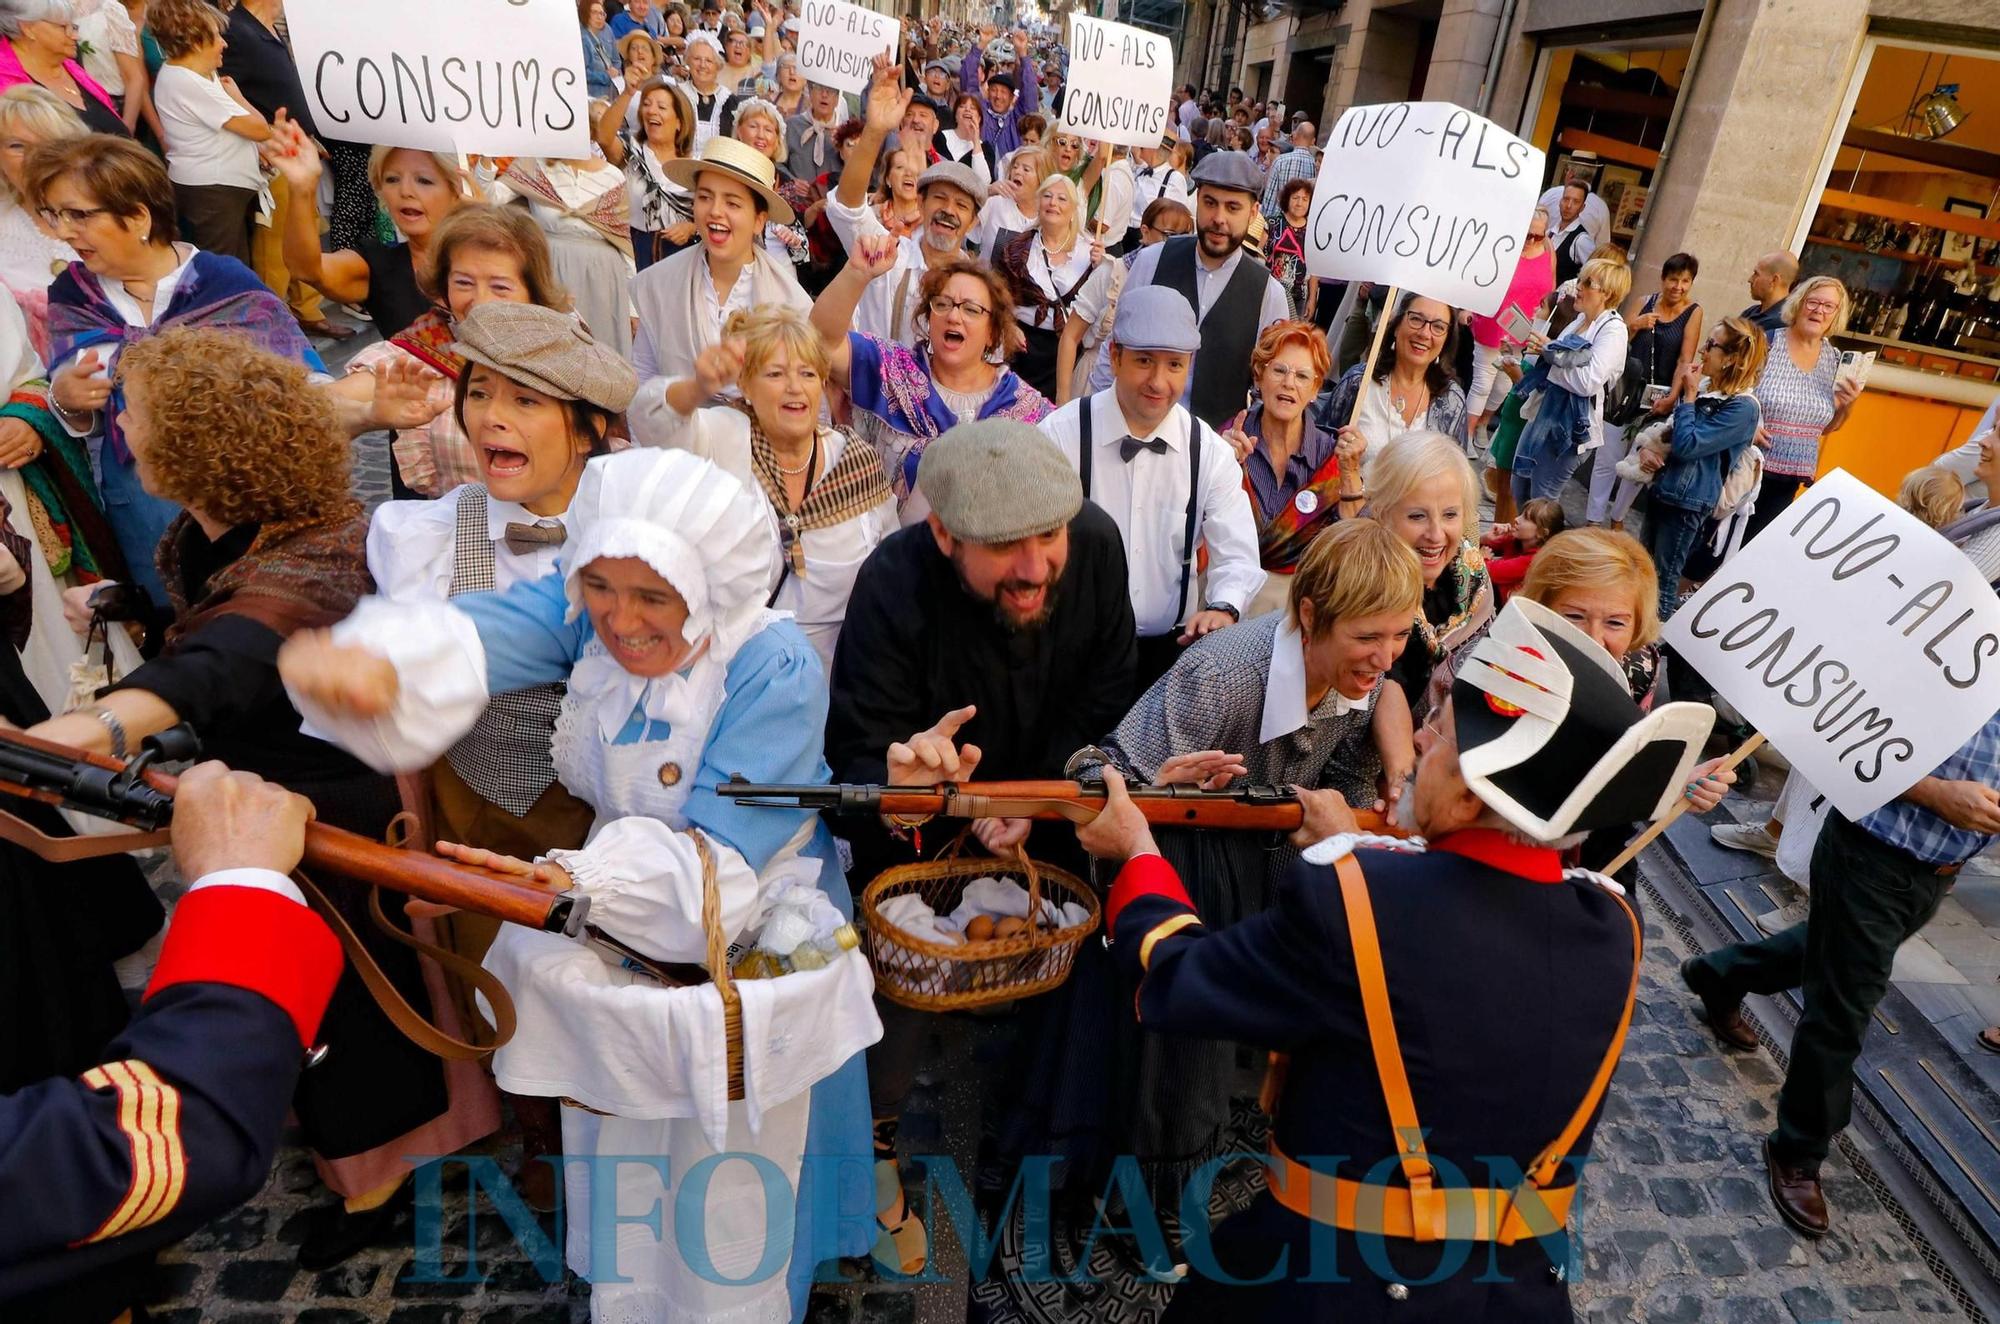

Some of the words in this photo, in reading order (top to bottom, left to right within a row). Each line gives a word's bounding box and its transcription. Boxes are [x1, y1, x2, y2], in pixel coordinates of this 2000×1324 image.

[806, 1, 884, 38] NO-ALS
[1074, 22, 1156, 69] NO-ALS
[315, 50, 576, 136] CONSUMS
[801, 40, 874, 80] CONSUM
[1066, 88, 1165, 134] CONSUMS
[1313, 194, 1516, 288] CONSUMS
[1789, 497, 1999, 689] NO-ALS
[1690, 581, 1915, 783] CONSUMS
